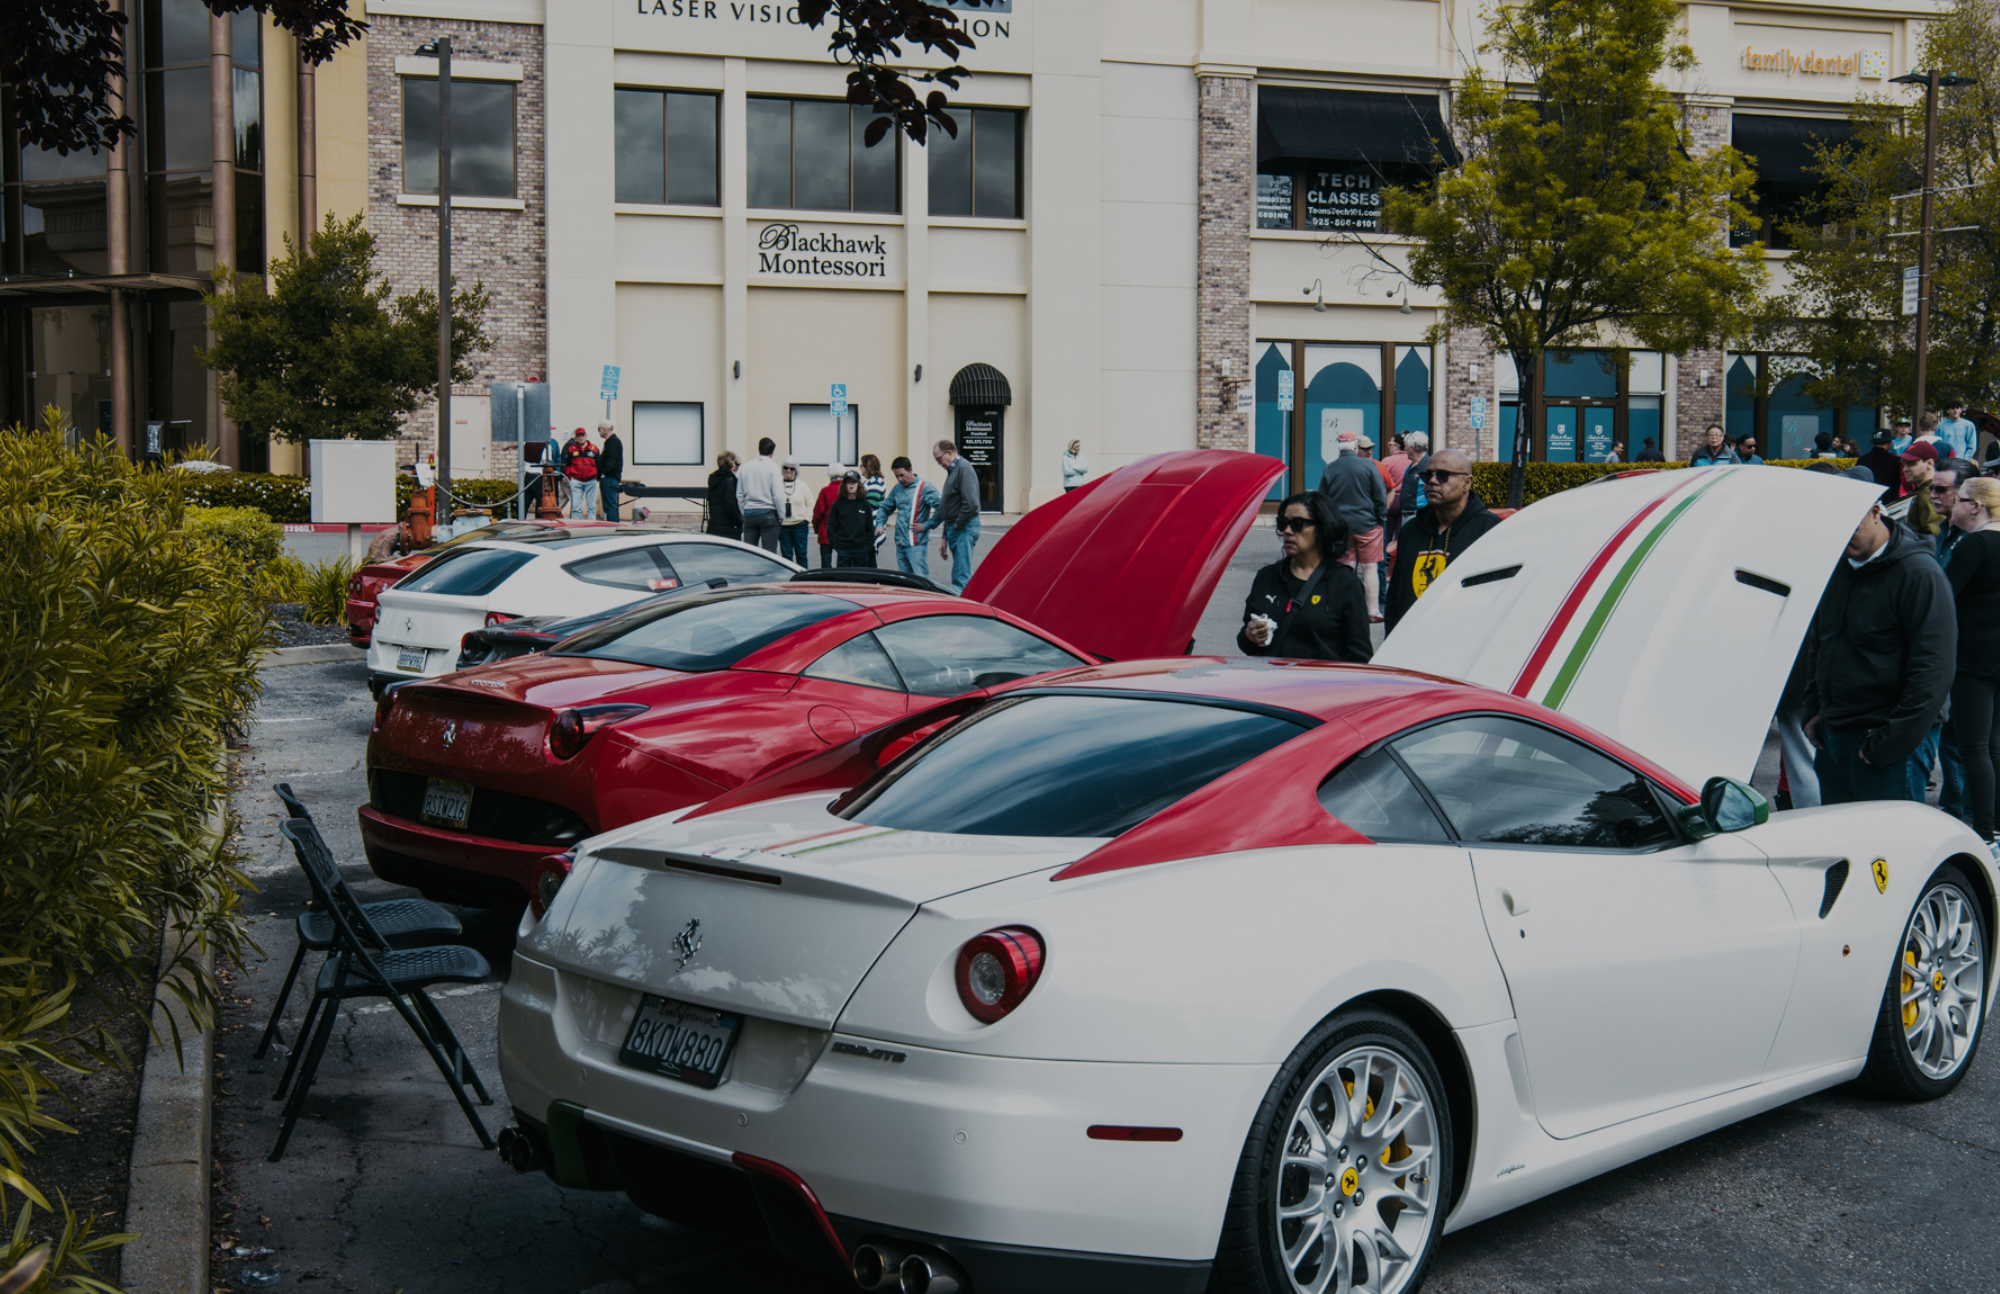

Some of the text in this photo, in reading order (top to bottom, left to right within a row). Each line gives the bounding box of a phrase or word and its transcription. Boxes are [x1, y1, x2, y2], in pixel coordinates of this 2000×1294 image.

[638, 0, 717, 19] LASER
[730, 2, 824, 26] VISIO
[1745, 45, 1857, 75] family dental
[1318, 172, 1371, 189] TECH
[1307, 189, 1380, 206] CLASSES
[1257, 211, 1289, 219] CODING
[758, 223, 887, 254] Blackhawk
[758, 252, 886, 277] Montessori
[659, 1002, 720, 1029] California
[1262, 1075, 1303, 1170] MICHELIN
